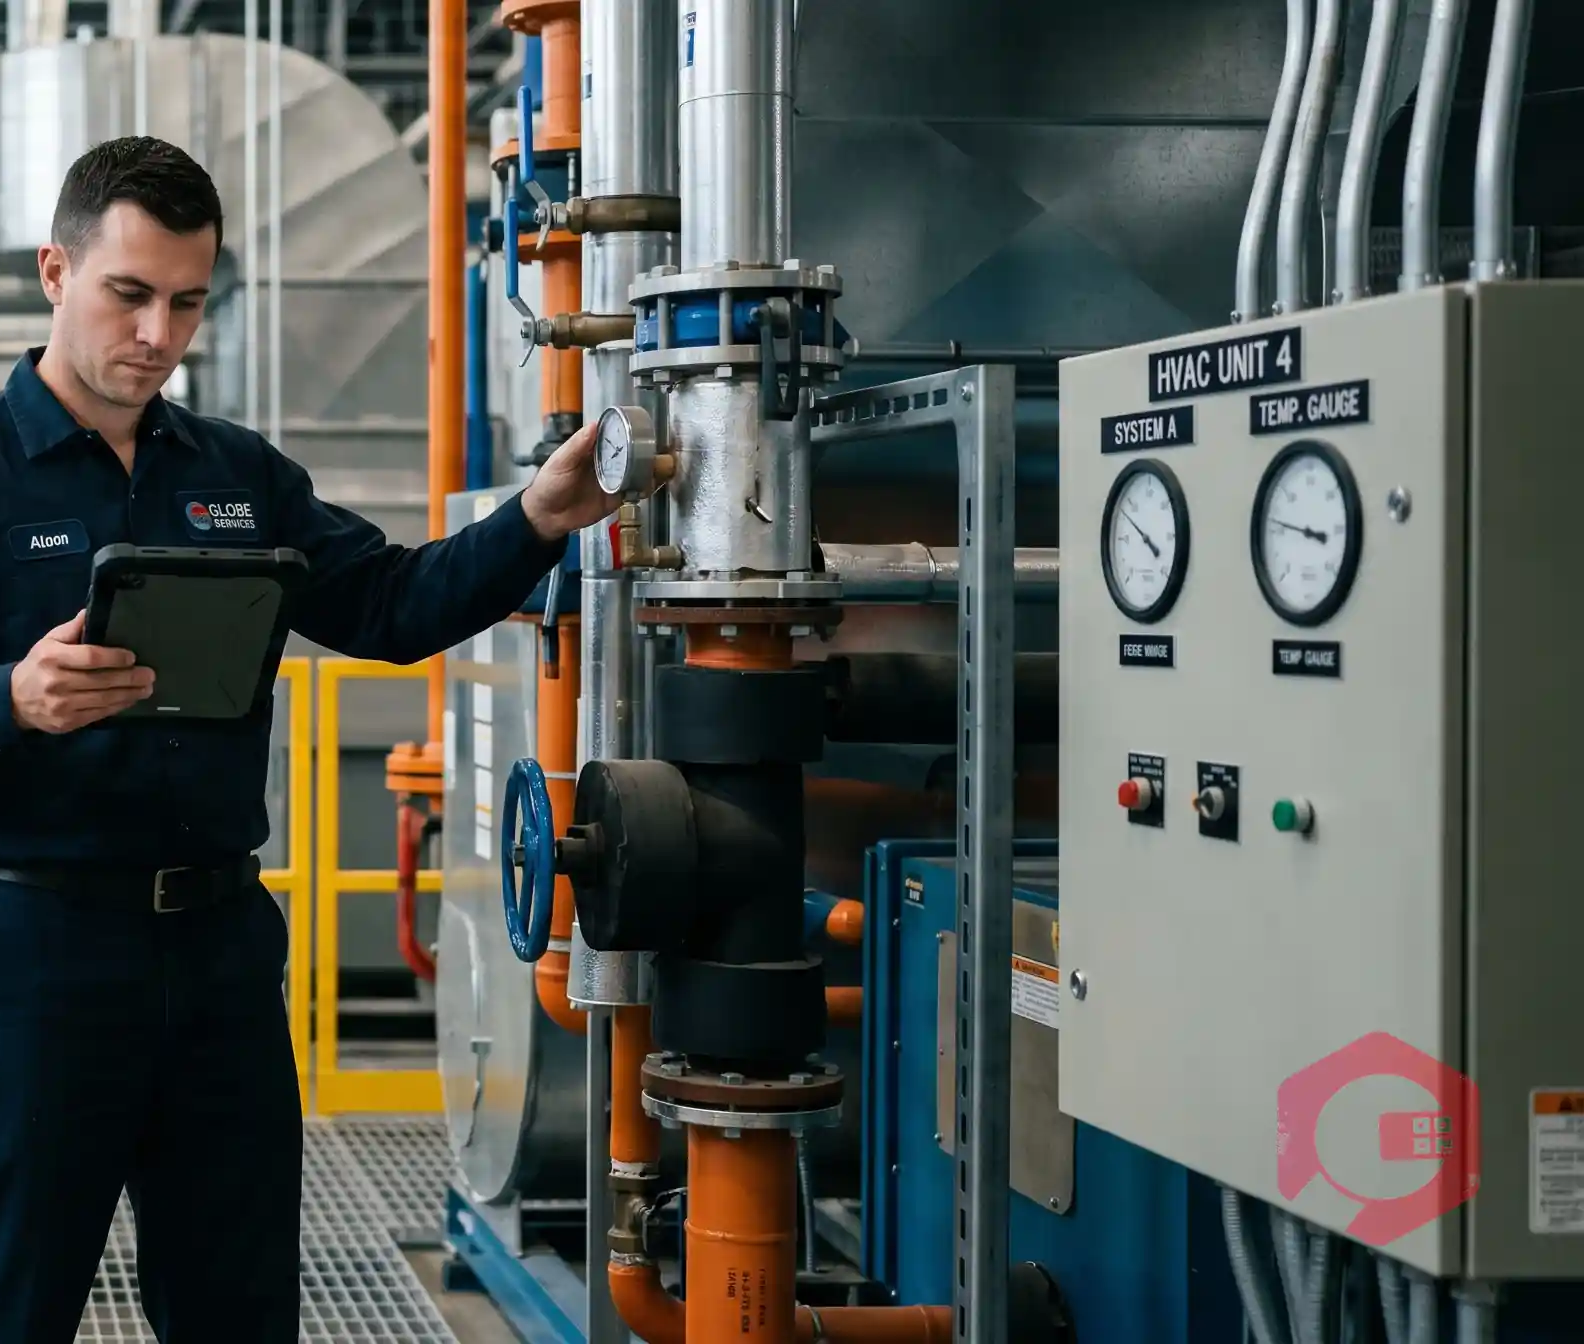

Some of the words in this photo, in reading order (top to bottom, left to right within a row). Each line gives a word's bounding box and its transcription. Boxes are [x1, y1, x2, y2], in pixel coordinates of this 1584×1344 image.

[1157, 350, 1211, 395] HVAC
[1218, 340, 1269, 384] UNIT
[1276, 336, 1292, 376] 4
[1259, 396, 1304, 427] TEMP.
[1307, 388, 1360, 422] GAUGE
[1115, 416, 1163, 445] SYSTEM
[1167, 414, 1177, 440] A
[209, 503, 253, 518] GLOBE
[214, 518, 256, 529] SERVICES
